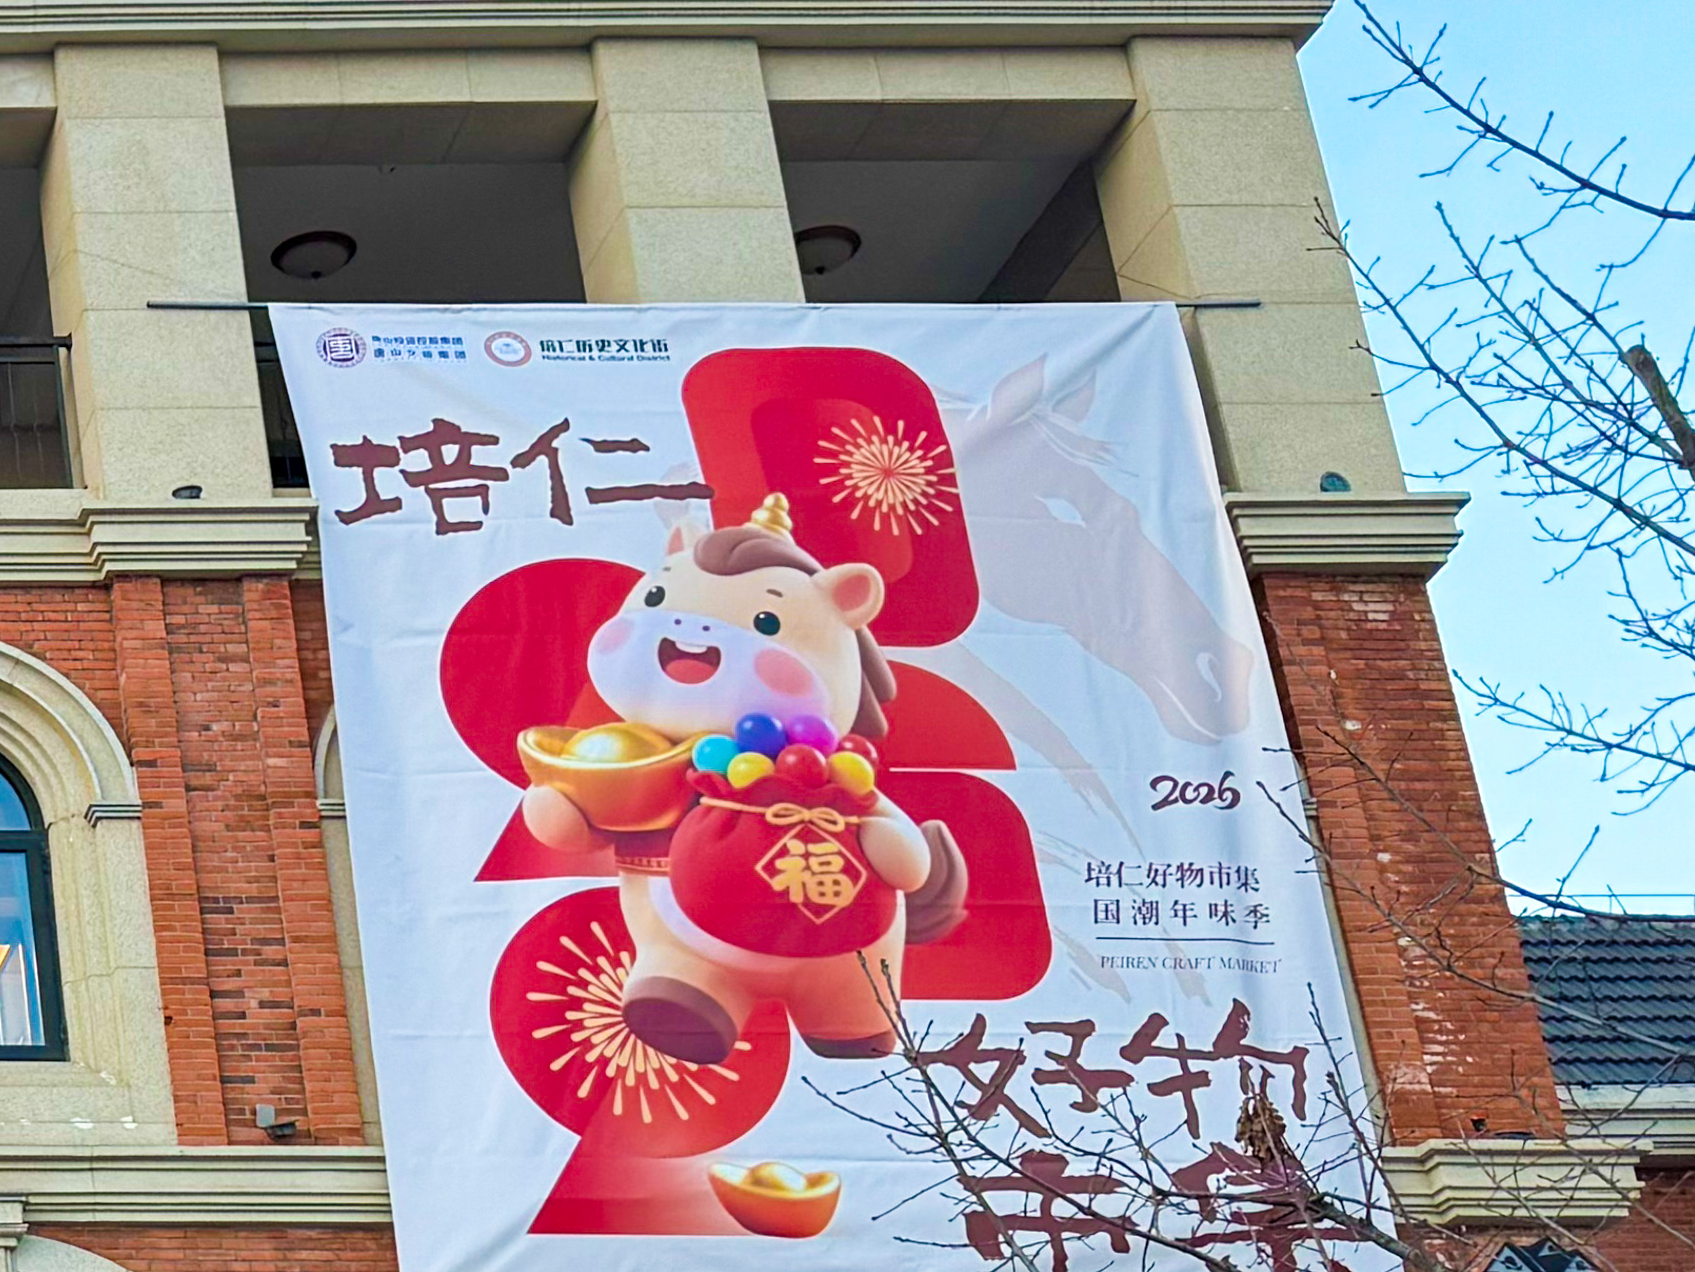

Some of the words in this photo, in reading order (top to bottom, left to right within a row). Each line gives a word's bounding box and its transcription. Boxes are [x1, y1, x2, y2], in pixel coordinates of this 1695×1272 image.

[330, 418, 715, 535] 培仁
[1150, 770, 1241, 811] 2026
[770, 840, 848, 907] 福
[1084, 860, 1260, 892] 培仁好物市集
[1092, 898, 1271, 929] 国潮年味季
[1099, 955, 1157, 971] PEIREN
[1161, 956, 1214, 972] CRAFT
[1218, 957, 1282, 974] MARKET
[910, 998, 1309, 1139] 好物
